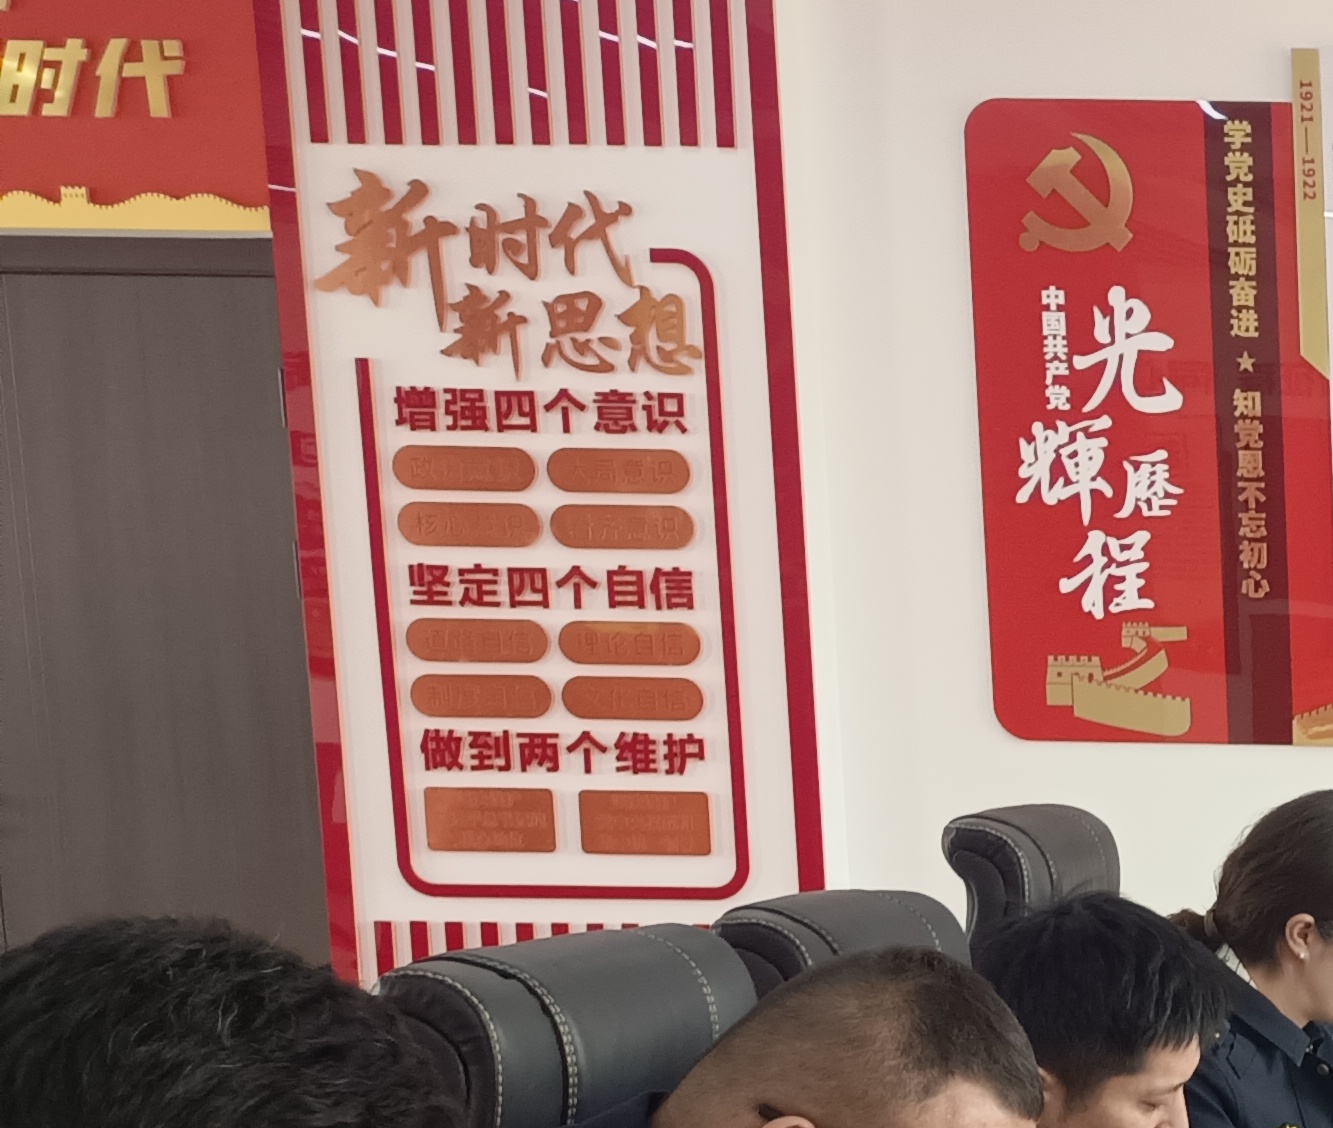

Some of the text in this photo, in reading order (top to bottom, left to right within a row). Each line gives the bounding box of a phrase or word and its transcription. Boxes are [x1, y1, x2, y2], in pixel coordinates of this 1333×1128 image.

[0, 37, 185, 119] 时代
[314, 168, 633, 332] 新时代
[440, 283, 702, 380] 新思想
[1041, 285, 1071, 411] 中国共产党
[1223, 119, 1269, 600] 学党史砥砺奋进 知党恩不忘初心
[393, 385, 690, 434] 增强四个意识
[407, 563, 695, 610] 坚定四个自信
[420, 729, 705, 775] 做到两个维护
